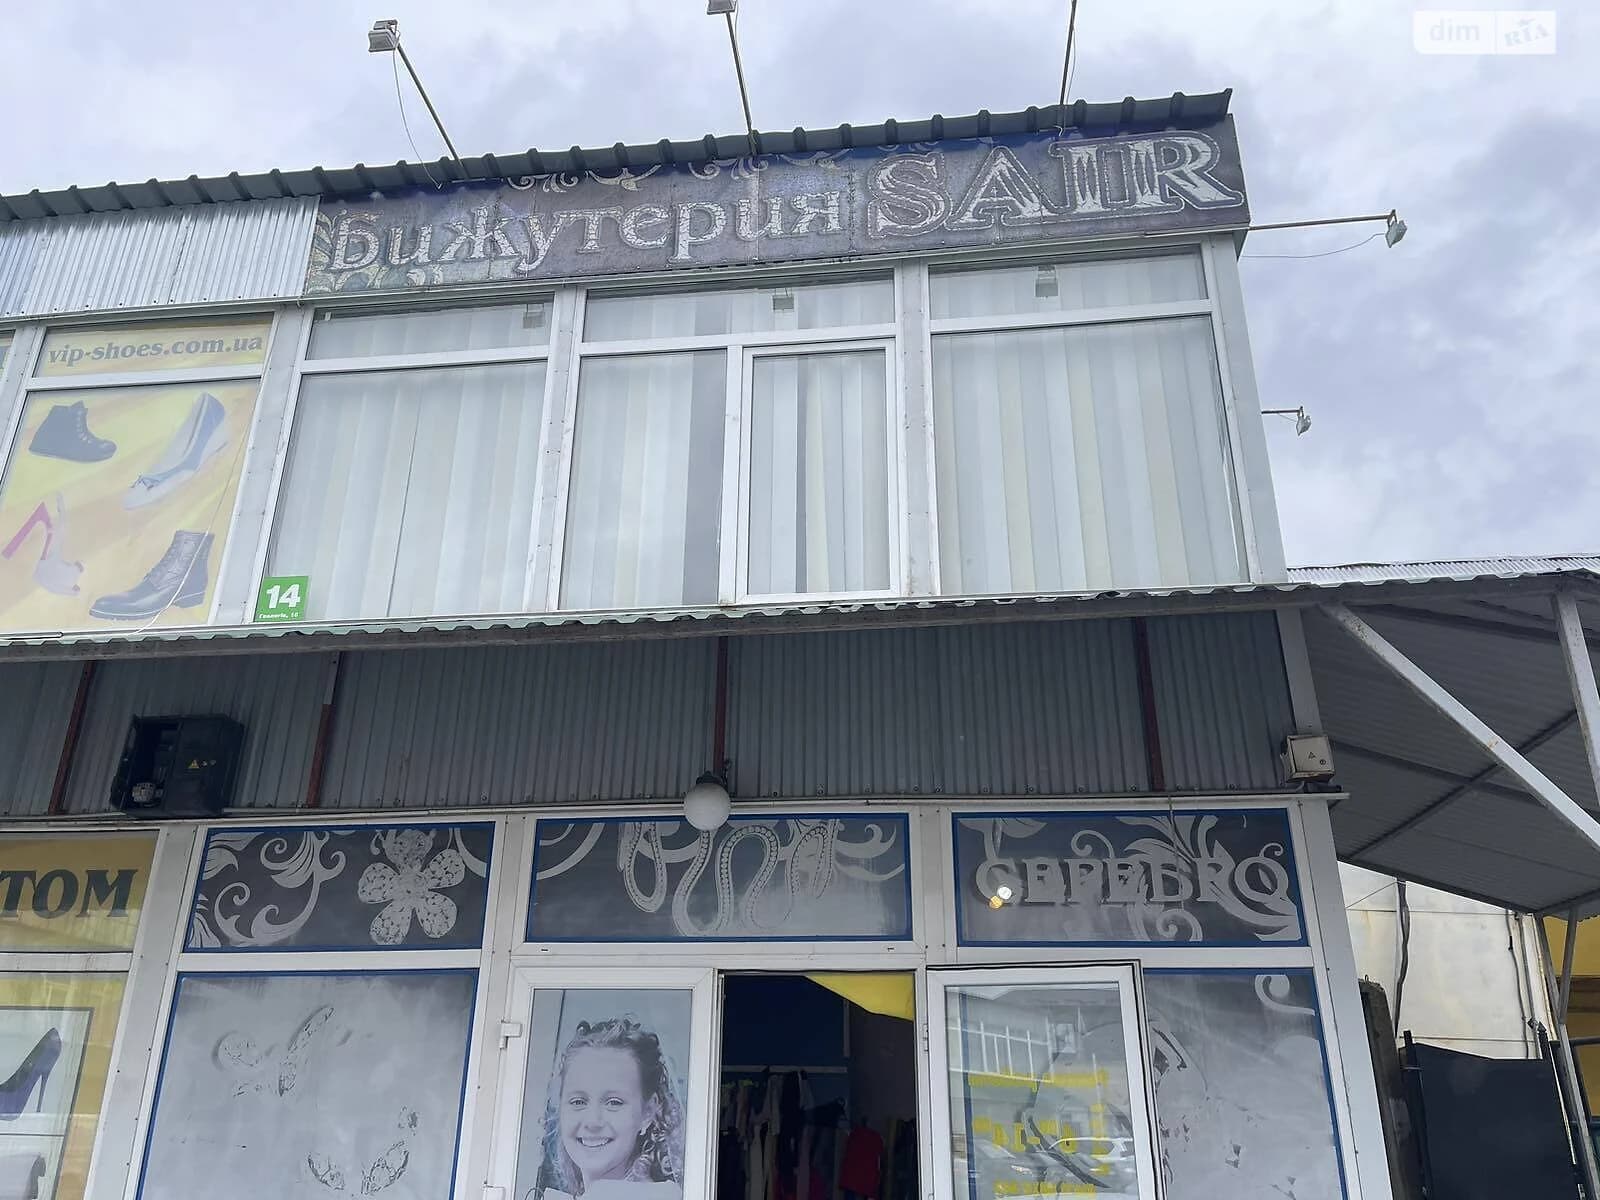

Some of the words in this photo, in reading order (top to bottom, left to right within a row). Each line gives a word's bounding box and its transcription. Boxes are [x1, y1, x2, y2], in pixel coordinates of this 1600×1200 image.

[329, 189, 845, 272] Бижутерия
[48, 335, 264, 367] vip-shoes.com.ua
[266, 583, 301, 609] 14
